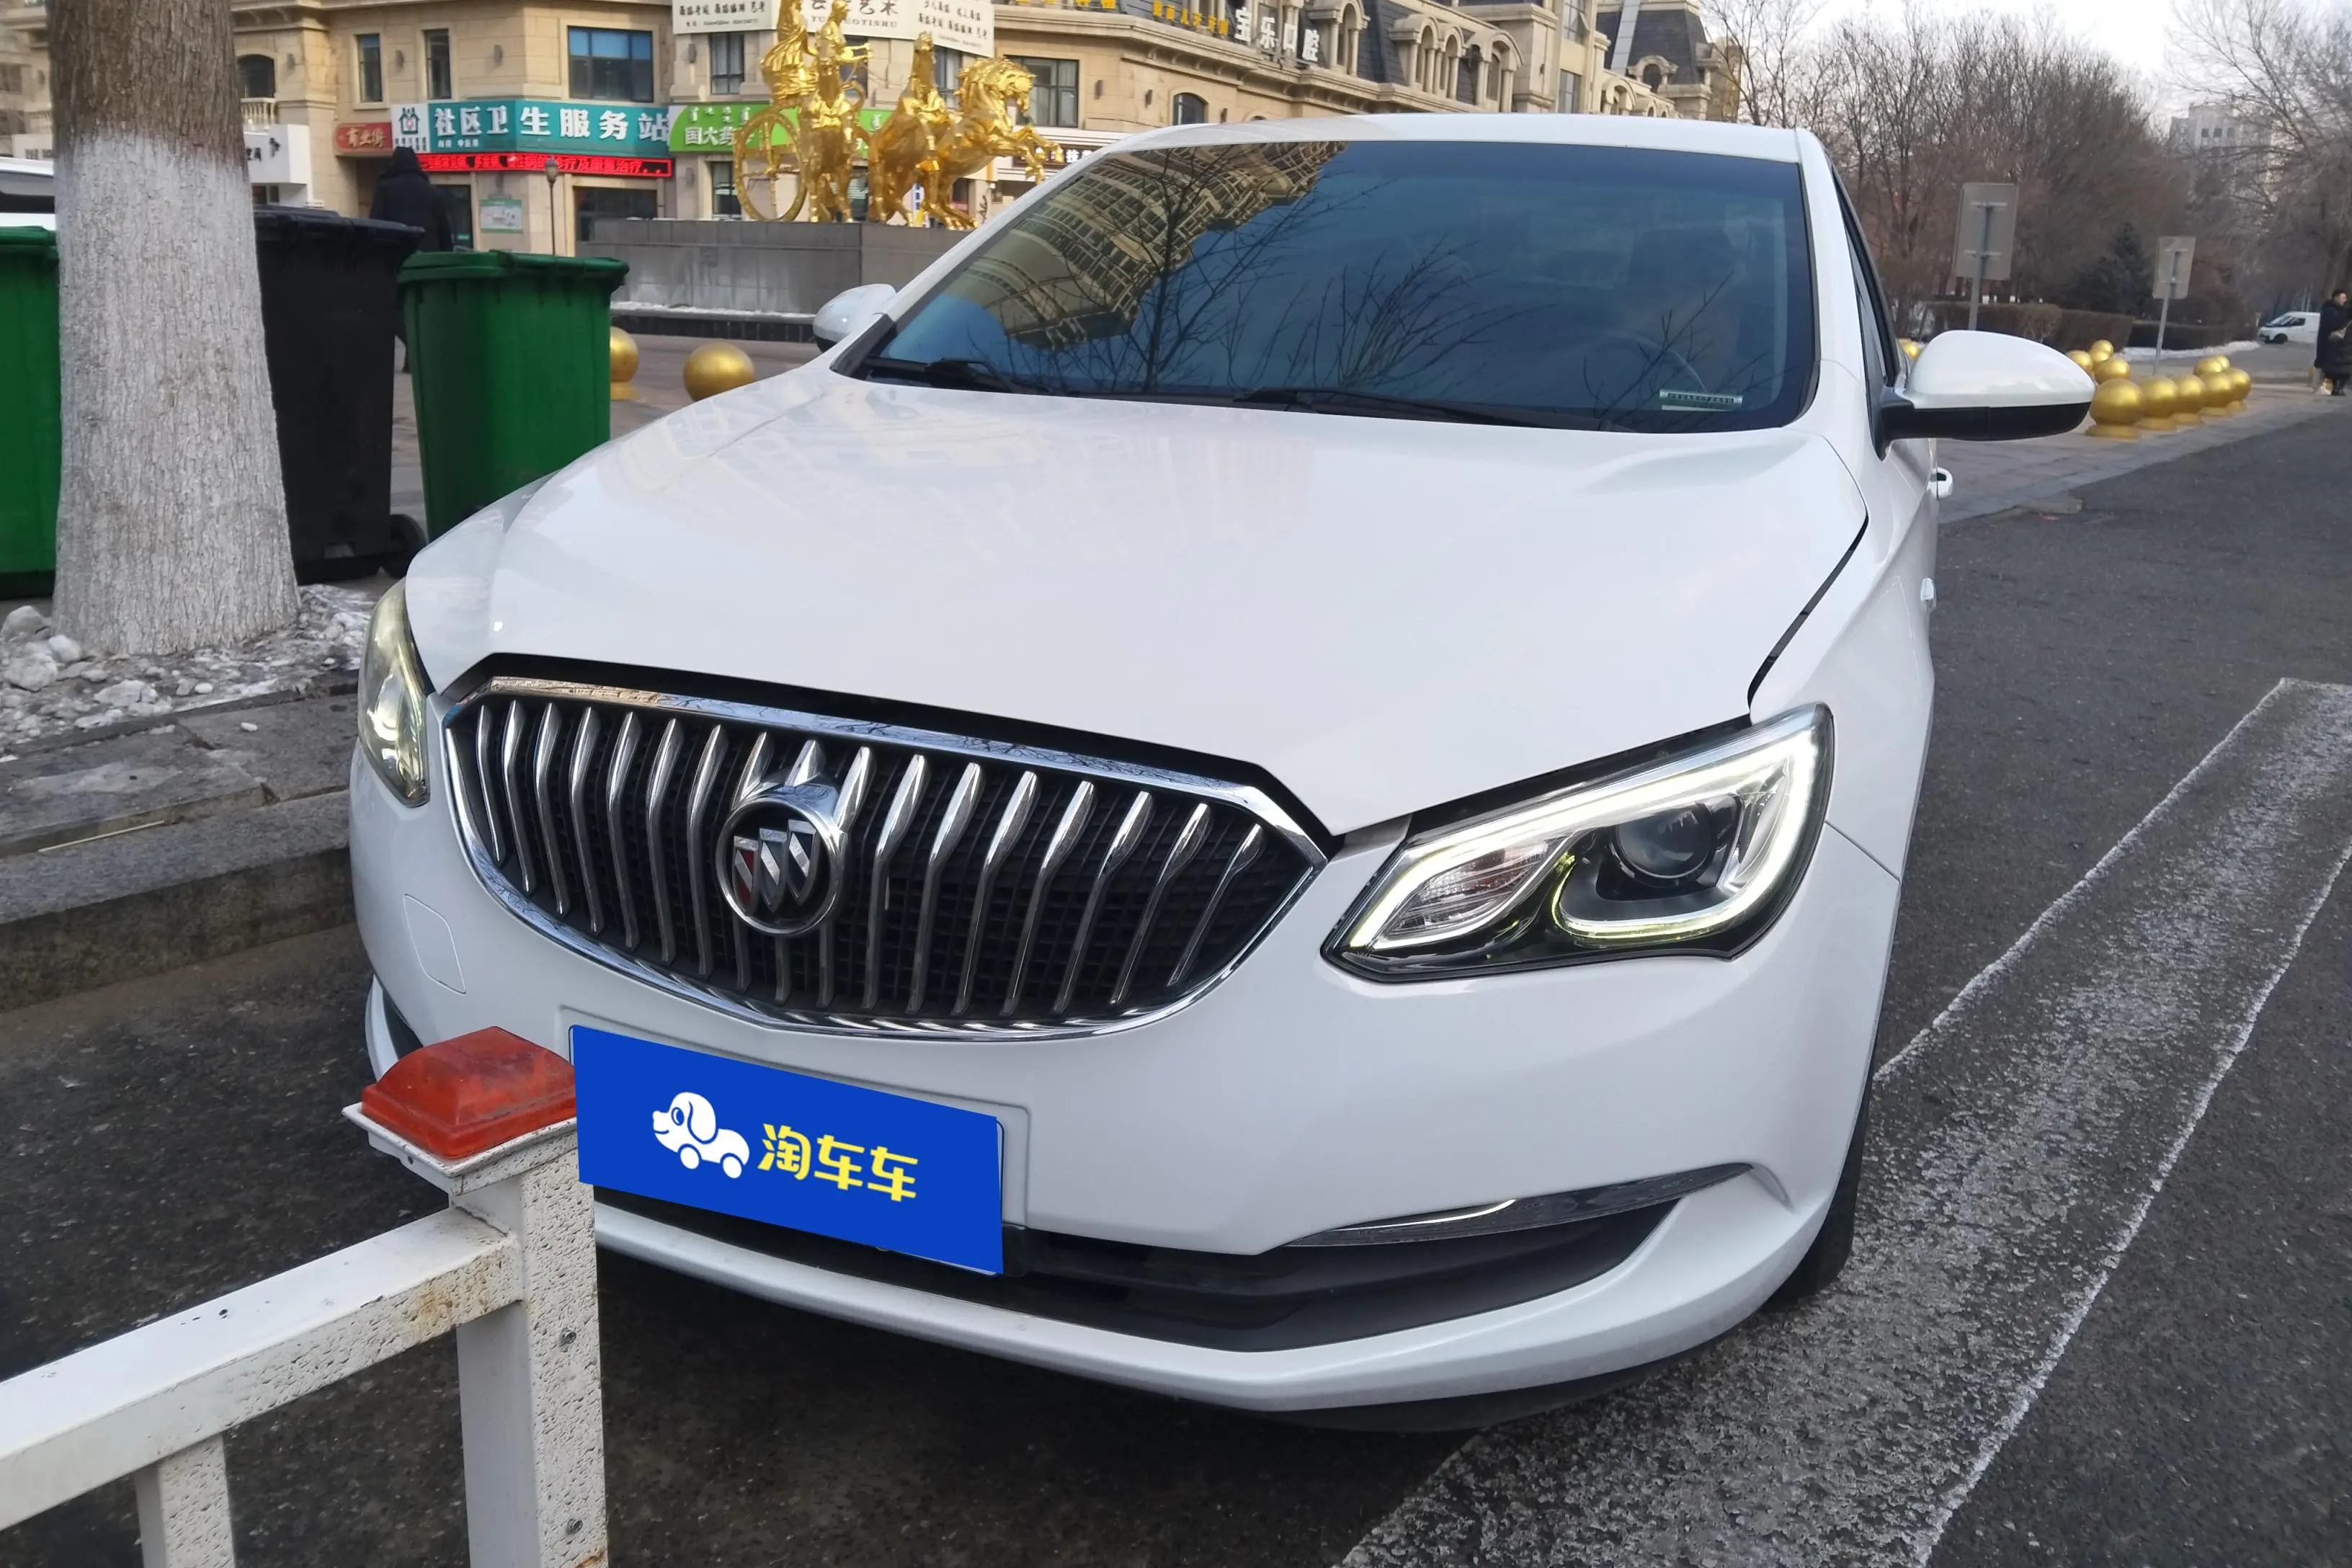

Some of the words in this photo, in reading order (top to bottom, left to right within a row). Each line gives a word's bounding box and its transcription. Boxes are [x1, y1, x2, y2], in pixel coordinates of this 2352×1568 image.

[1234, 6, 1320, 63] 宝乐口腔
[434, 104, 670, 142] 社区卫生服务站
